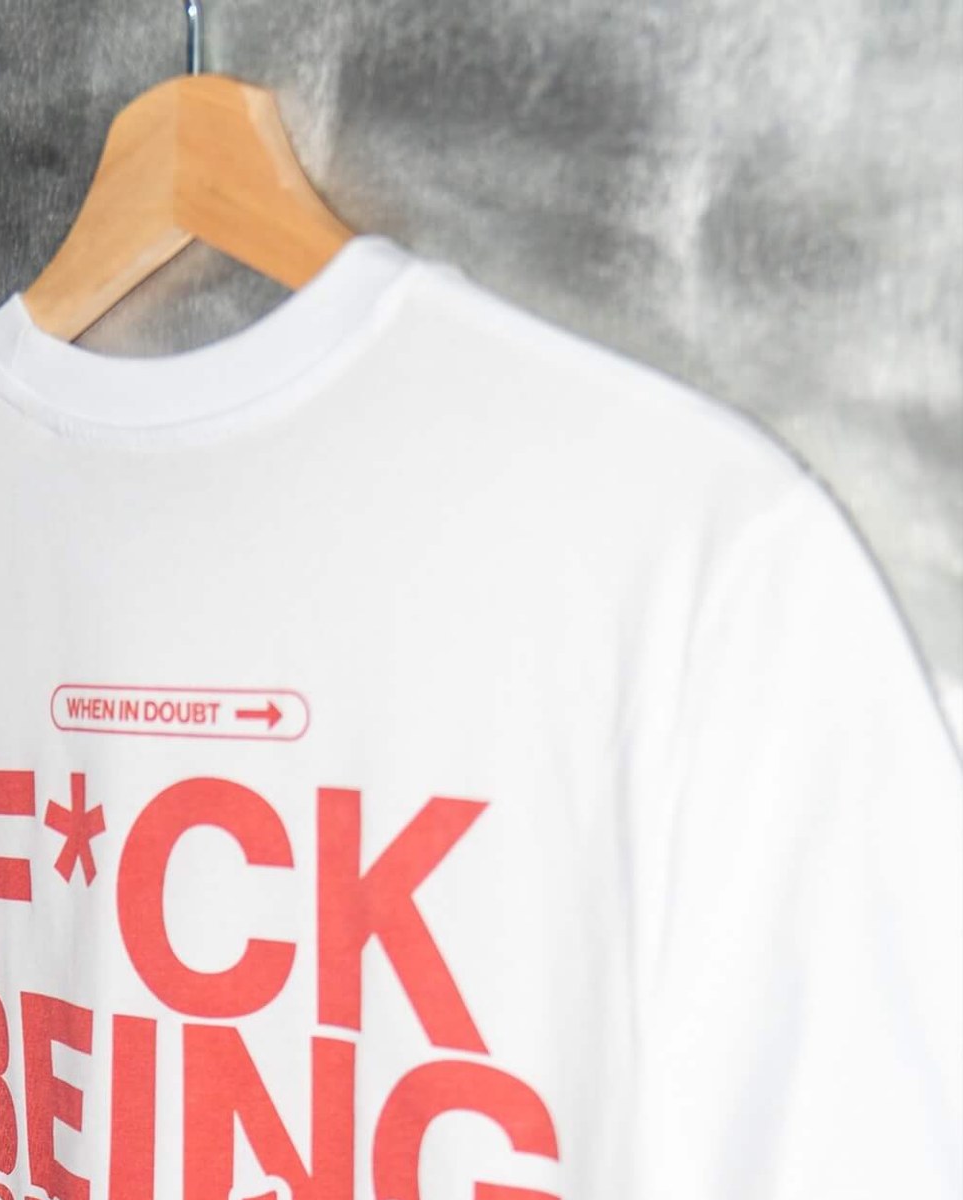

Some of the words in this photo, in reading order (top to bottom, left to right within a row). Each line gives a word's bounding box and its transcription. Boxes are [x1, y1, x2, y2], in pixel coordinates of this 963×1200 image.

[66, 697, 115, 721] WHEN
[119, 699, 138, 722] IN
[143, 701, 220, 724] DOUBT
